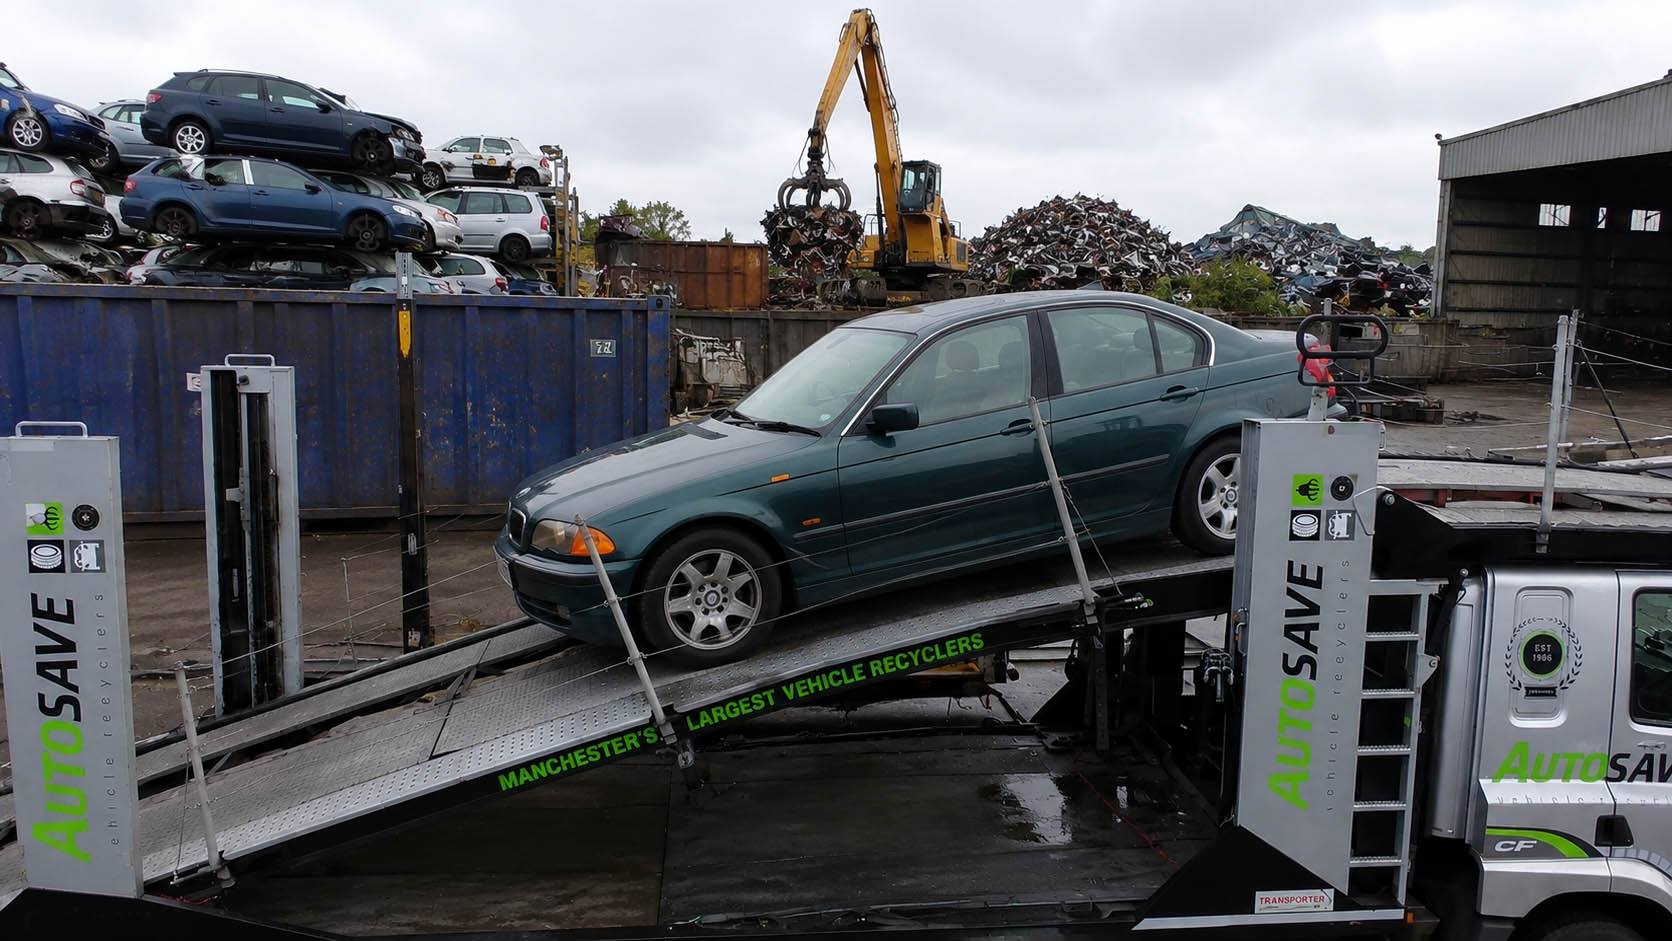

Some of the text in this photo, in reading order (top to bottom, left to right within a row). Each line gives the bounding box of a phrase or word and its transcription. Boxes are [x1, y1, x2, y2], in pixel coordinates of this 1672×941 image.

[1534, 644, 1552, 652] EST
[498, 632, 985, 791] MANCHESTER'S LARGEST VEHICLE RECYCLERS
[1494, 840, 1538, 852] CF
[1259, 895, 1325, 905] TRANSPORTER
